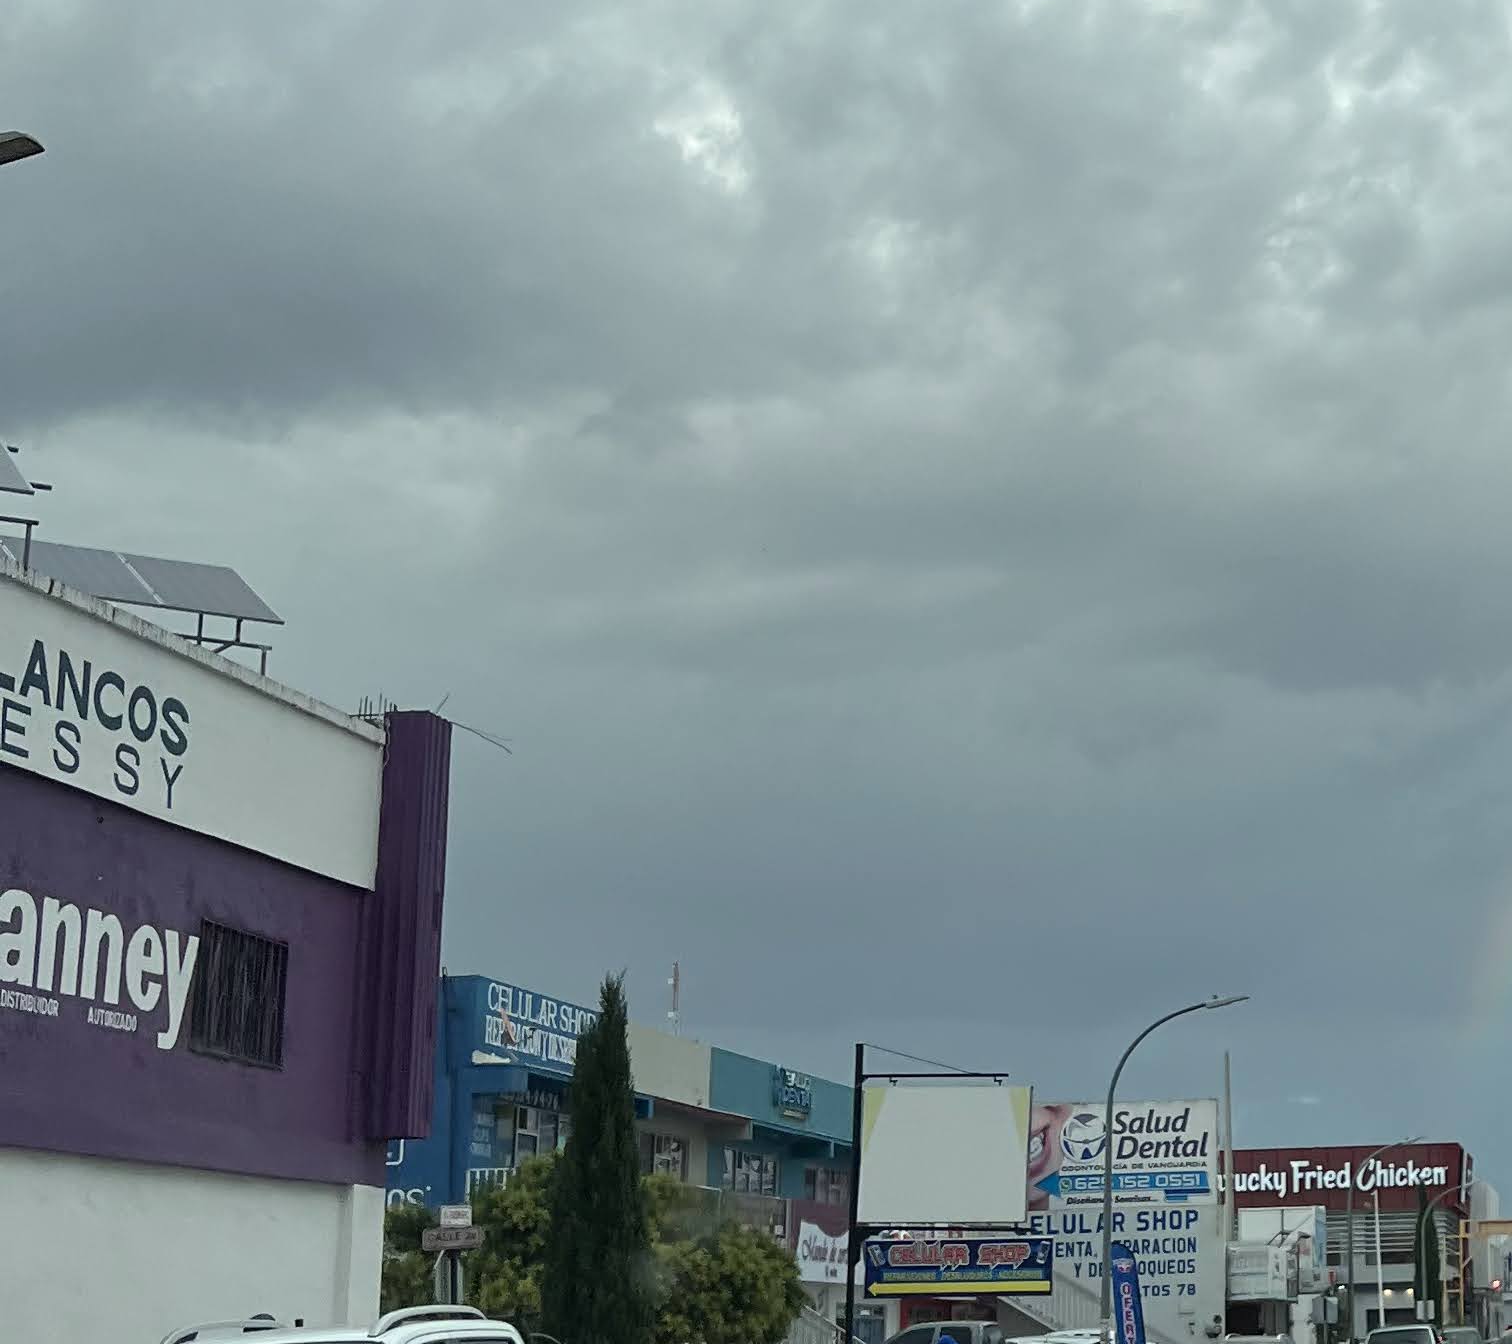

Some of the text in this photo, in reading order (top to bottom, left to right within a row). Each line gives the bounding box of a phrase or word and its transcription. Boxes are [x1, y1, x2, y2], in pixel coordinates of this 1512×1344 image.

[487, 982, 558, 1029] CELULAR
[88, 1007, 138, 1033] AUTORIZADO
[1112, 1108, 1190, 1135] Salud
[1116, 1132, 1209, 1160] Dental
[1119, 1176, 1150, 1188] 152
[1155, 1173, 1200, 1187] 0551
[1290, 1160, 1351, 1193] Fried
[1356, 1158, 1449, 1192] Chicken
[1136, 1209, 1199, 1232] SHOP
[979, 1244, 1030, 1264] SHOP
[1073, 1262, 1082, 1278] Y
[1177, 1283, 1197, 1296] 78
